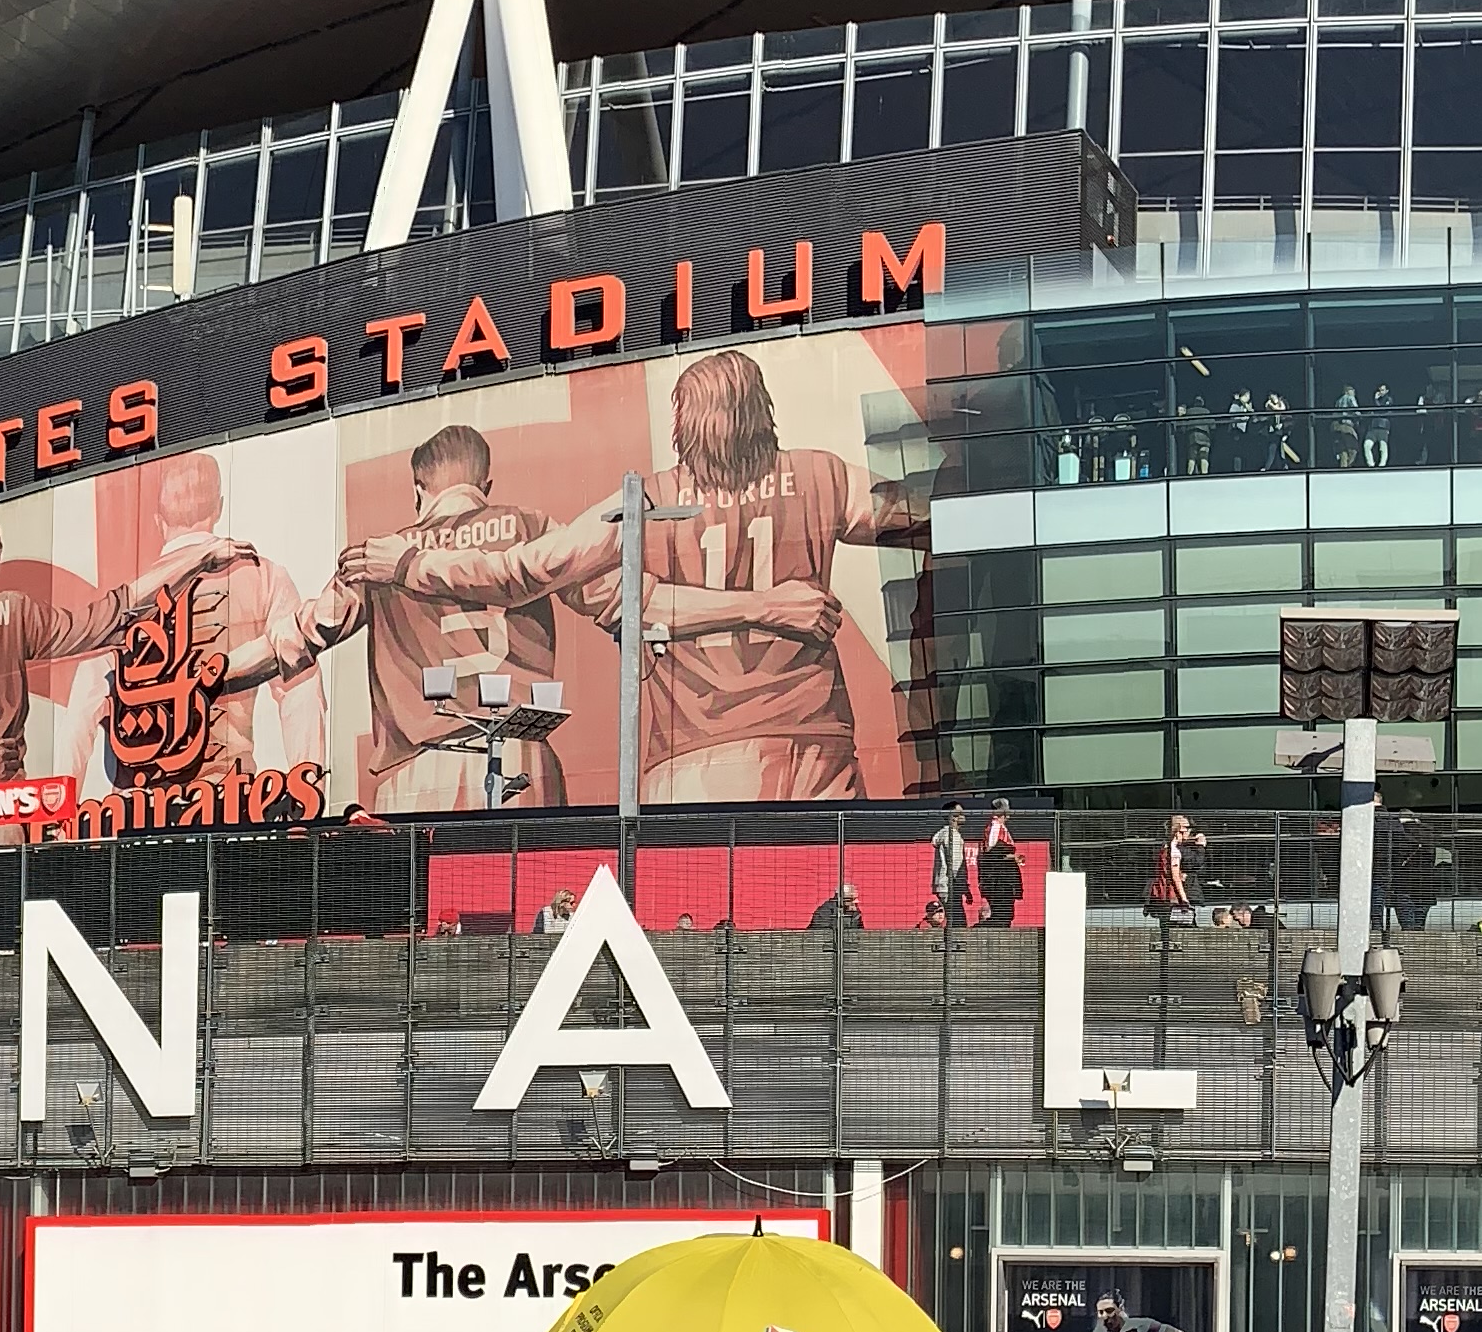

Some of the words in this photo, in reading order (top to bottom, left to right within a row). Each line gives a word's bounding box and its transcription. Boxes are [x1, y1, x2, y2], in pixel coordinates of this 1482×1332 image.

[270, 222, 946, 409] STADIUM
[29, 762, 325, 845] mirates
[393, 1251, 486, 1299] The
[1022, 1280, 1039, 1290] WE
[1041, 1280, 1062, 1290] ARE
[1065, 1280, 1086, 1290] THE
[1420, 1285, 1436, 1295] WE
[1439, 1285, 1460, 1295] ARE
[1463, 1285, 1482, 1295] THE
[1021, 1293, 1086, 1306] ARSENAL
